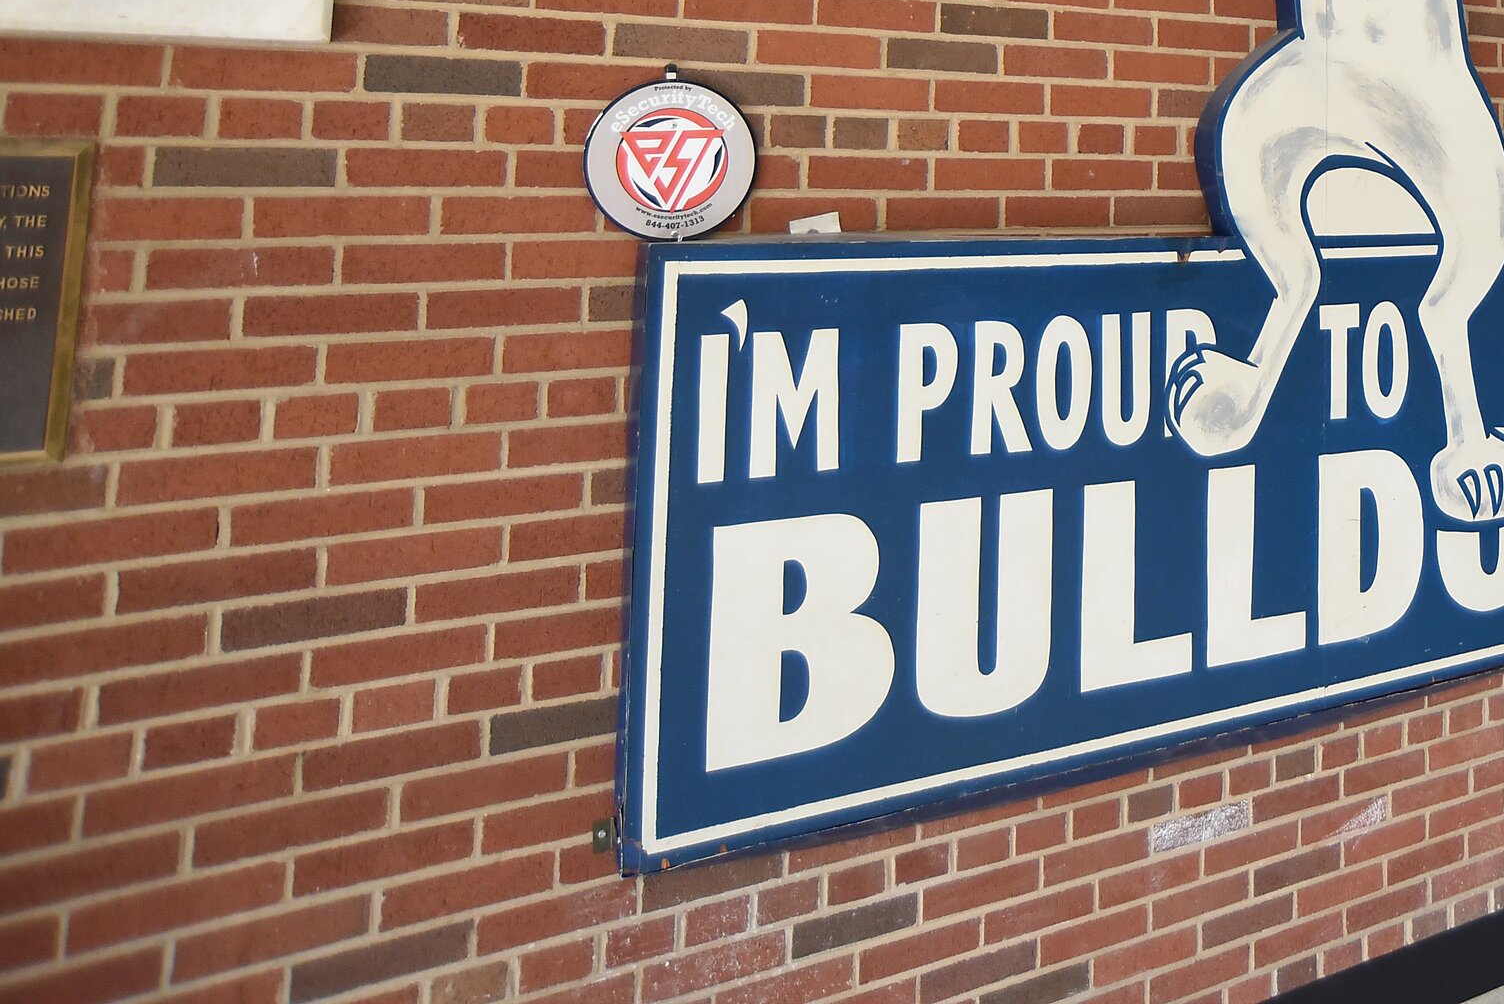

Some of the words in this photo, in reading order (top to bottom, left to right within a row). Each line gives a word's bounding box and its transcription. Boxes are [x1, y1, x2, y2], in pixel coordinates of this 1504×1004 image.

[684, 85, 693, 93] by
[611, 90, 736, 132] eSecurityTech
[635, 203, 713, 221] www.esecuritytech.com
[15, 215, 47, 228] THE
[645, 215, 705, 230] 844-407-1313
[6, 246, 45, 258] THIS
[697, 299, 840, 484] I'M
[1319, 301, 1409, 420] TO
